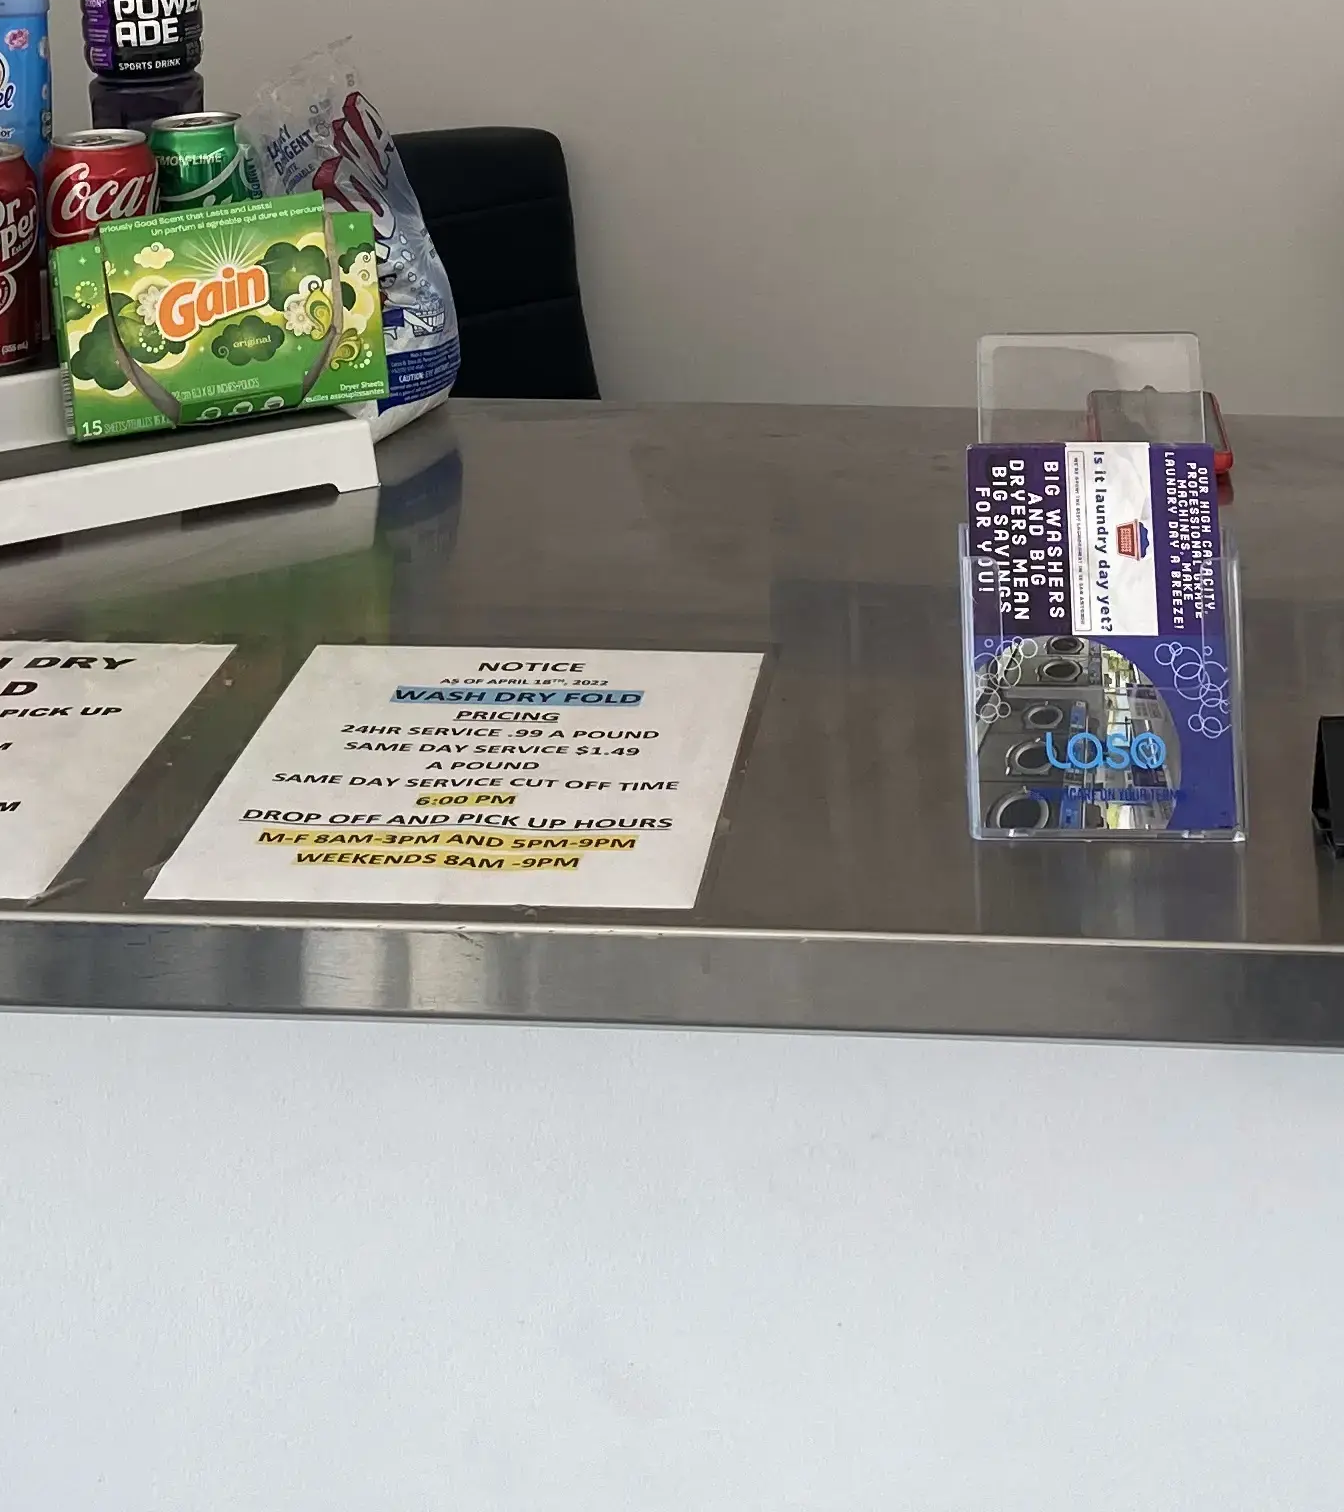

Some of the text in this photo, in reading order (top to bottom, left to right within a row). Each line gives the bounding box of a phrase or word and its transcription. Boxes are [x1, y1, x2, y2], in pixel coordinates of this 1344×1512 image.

[116, 17, 179, 47] ADE
[118, 58, 181, 70] SPORTS DRINK
[134, 218, 157, 228] Good
[159, 215, 184, 226] Scent
[186, 212, 204, 221] that
[206, 209, 229, 218] Lasts
[230, 206, 246, 215] and
[158, 266, 266, 340] Gain
[233, 335, 271, 349] original
[82, 419, 102, 437] 15
[1009, 460, 1029, 620] DRYERS MEAN
[1028, 493, 1046, 586] AND BIG
[1044, 461, 1065, 618] BIG WASHERS
[1094, 451, 1112, 632] Is it laundry day yet?
[25, 656, 136, 669] DRY
[478, 662, 586, 672] NOTICE
[394, 690, 643, 705] WASH DRY FOLD
[0, 707, 70, 717] PICK
[80, 707, 122, 716] UP
[455, 711, 560, 722] PRICING
[341, 725, 660, 739] 24HR SERVICE .99 A POUND
[344, 742, 640, 756] SAME DAY SERVICE $1.49
[425, 761, 540, 770] A POUND
[272, 773, 679, 791] SAME DAY SERVICE CUT OFF TIME
[416, 795, 516, 806] 6:00 PM
[243, 809, 673, 829] DROP OFF AND PICK UP HOURS
[258, 832, 636, 849] M-F 8AM-3PM AND 5PM-9PM
[297, 853, 580, 869] WEEKENDS 8AM -9PM
